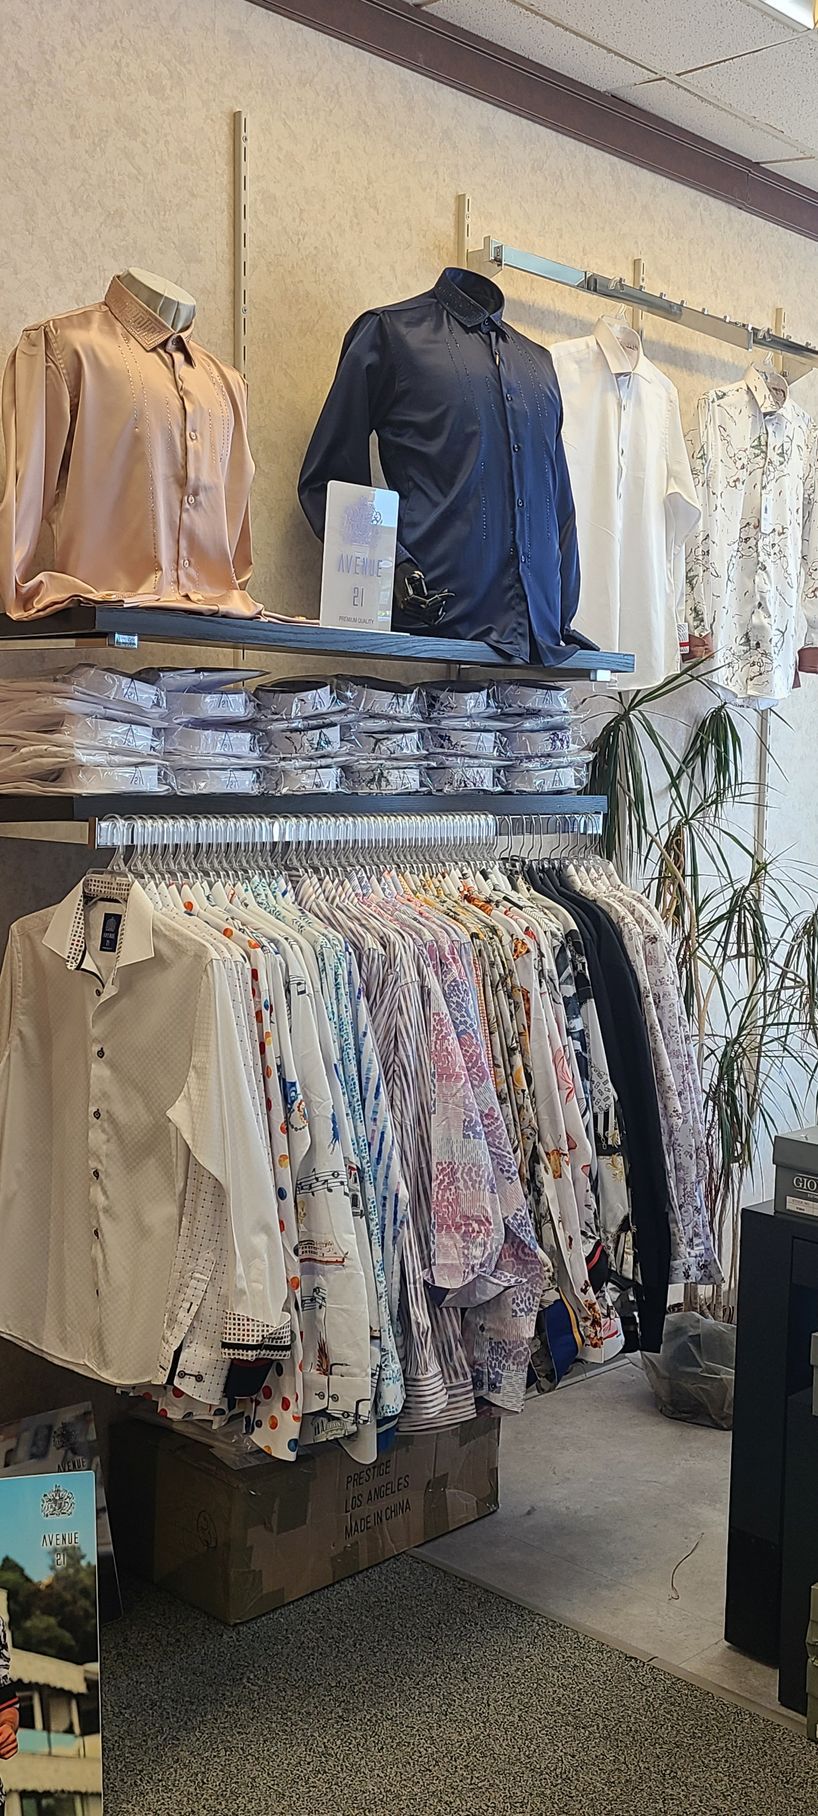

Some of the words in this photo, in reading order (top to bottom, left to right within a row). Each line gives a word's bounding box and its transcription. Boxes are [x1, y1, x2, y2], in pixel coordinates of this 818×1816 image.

[337, 553, 383, 578] AVENUE
[352, 587, 364, 607] 21
[338, 615, 357, 623] PREMIUM
[358, 617, 374, 625] QUALITY
[57, 1457, 86, 1473] AVENUE
[345, 1459, 391, 1490] PRESTIGE
[344, 1493, 363, 1514] LOS
[366, 1474, 410, 1505] ANGELES
[344, 1513, 371, 1540] MADE
[373, 1510, 383, 1526] IN
[384, 1498, 411, 1521] CHINA
[41, 1531, 79, 1547] AVENUE
[55, 1552, 66, 1567] 21
